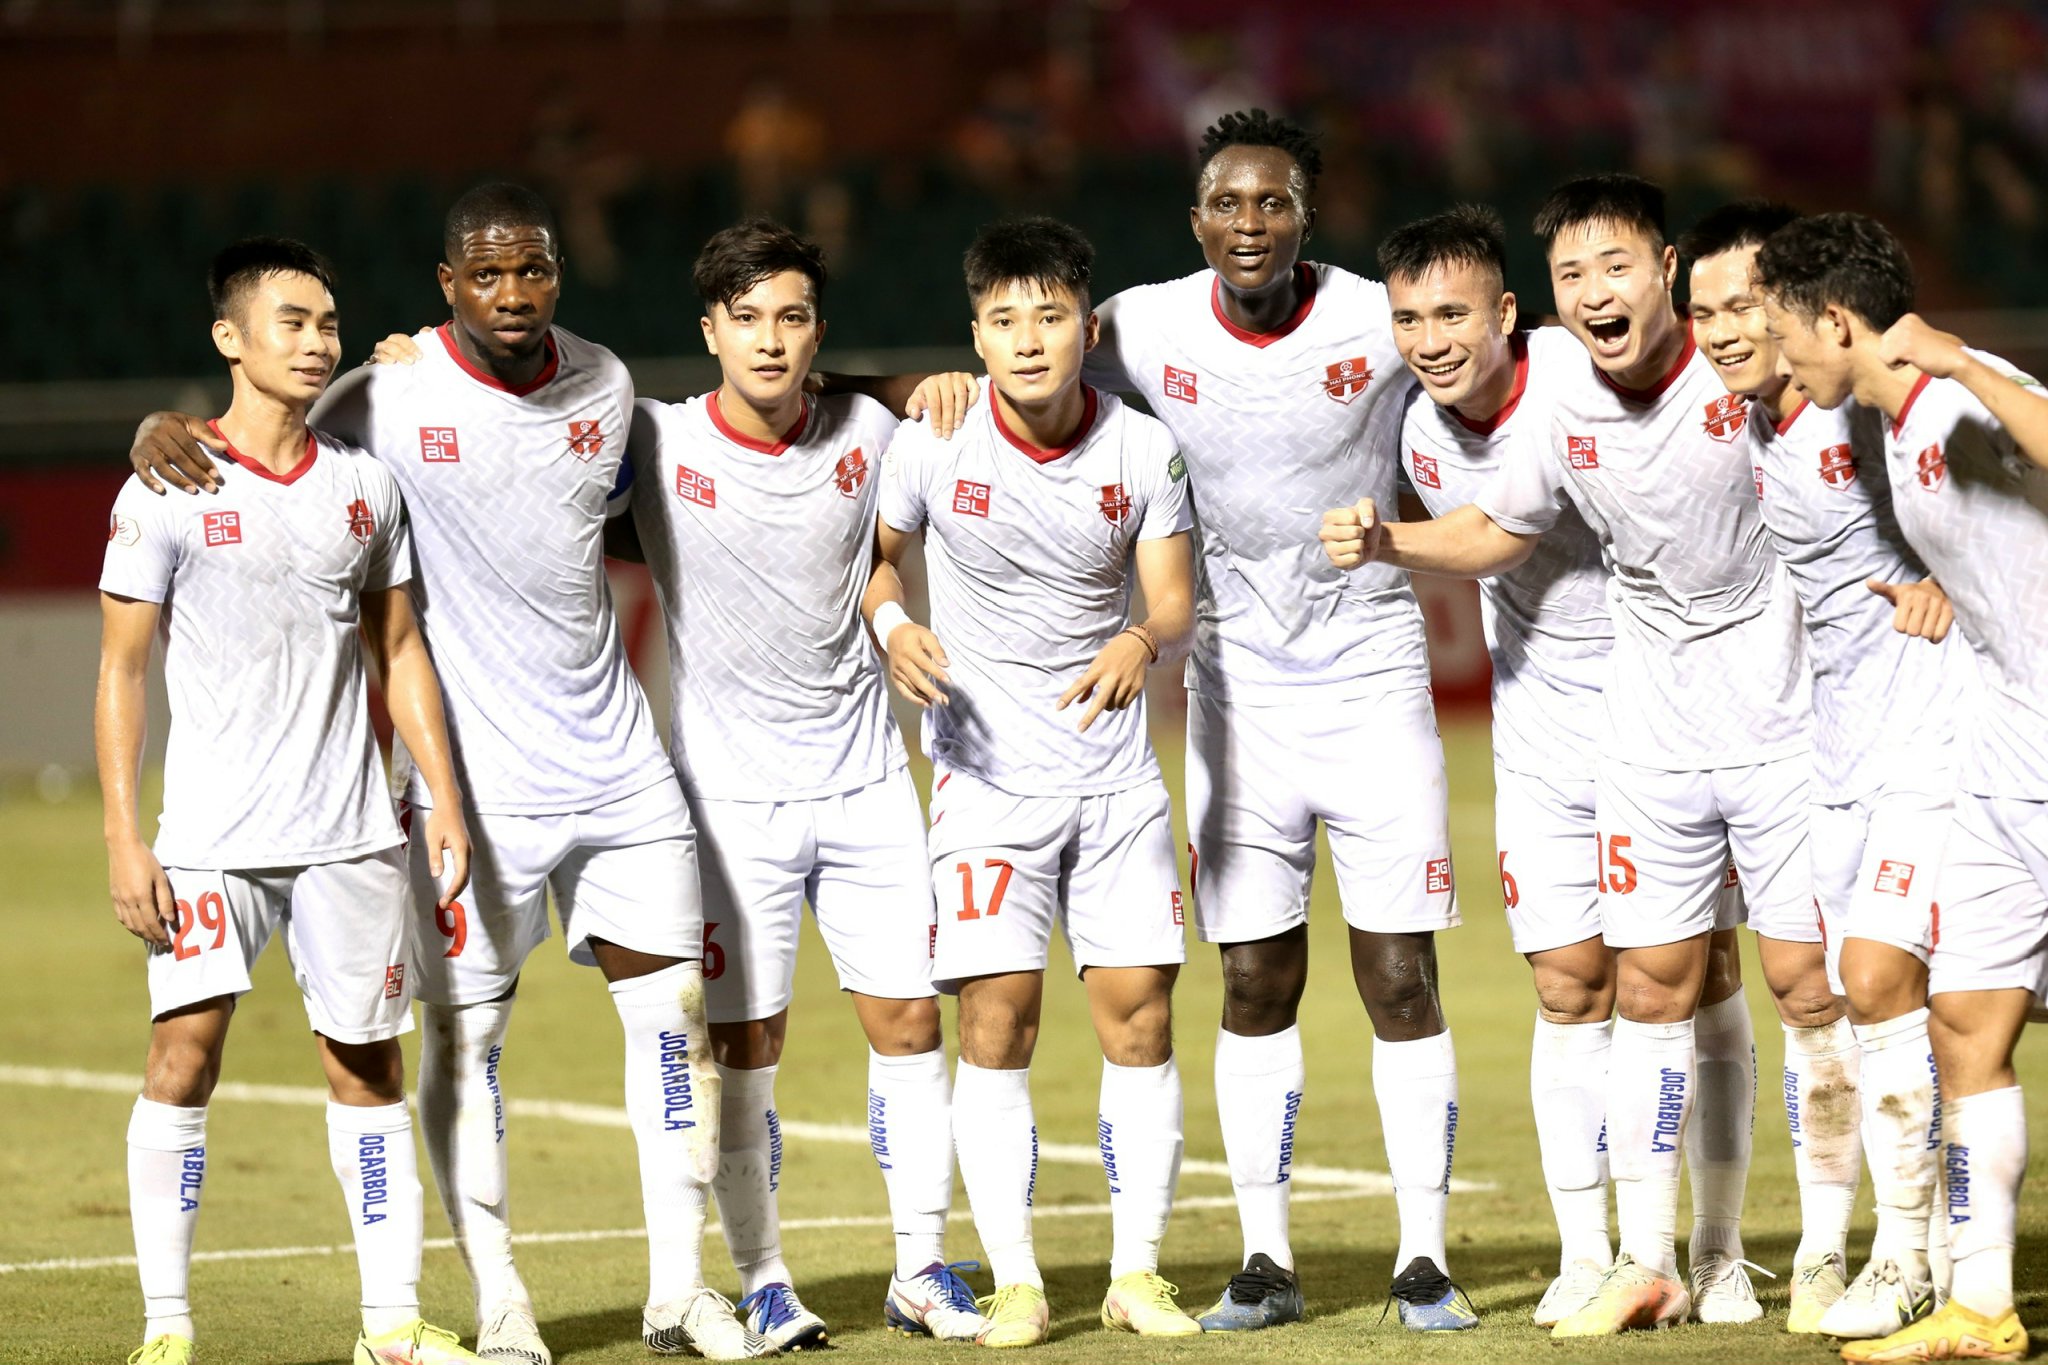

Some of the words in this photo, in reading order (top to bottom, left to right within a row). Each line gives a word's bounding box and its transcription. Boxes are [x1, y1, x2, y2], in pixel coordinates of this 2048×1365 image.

[1167, 370, 1194, 386] JG
[1167, 384, 1194, 400] BL
[424, 430, 454, 443] JG
[424, 445, 456, 459] BL
[1571, 439, 1592, 451] JG
[1416, 456, 1435, 472] JG
[1571, 454, 1595, 466] BL
[681, 470, 710, 489] JG
[1416, 468, 1438, 486] BL
[680, 482, 712, 504] BL
[958, 484, 987, 499] JG
[956, 499, 985, 514] BL
[208, 514, 236, 528] JG
[208, 529, 238, 544] BL
[1428, 862, 1448, 876] JG
[1597, 832, 1637, 894] 15
[956, 858, 1014, 921] 17
[1428, 878, 1449, 890] BL
[173, 891, 226, 961] 29
[435, 900, 467, 958] 9
[388, 968, 402, 981] JG
[387, 984, 400, 996] BL
[659, 1031, 696, 1131] JOGARBOLA
[486, 1044, 504, 1143] JOGARBOLA
[1652, 1068, 1686, 1152] JOGARBOLA
[1277, 1090, 1302, 1184] JOGARBOLA
[358, 1134, 387, 1225] OGARBOLA
[1946, 1142, 1971, 1225] JOGARBOLA
